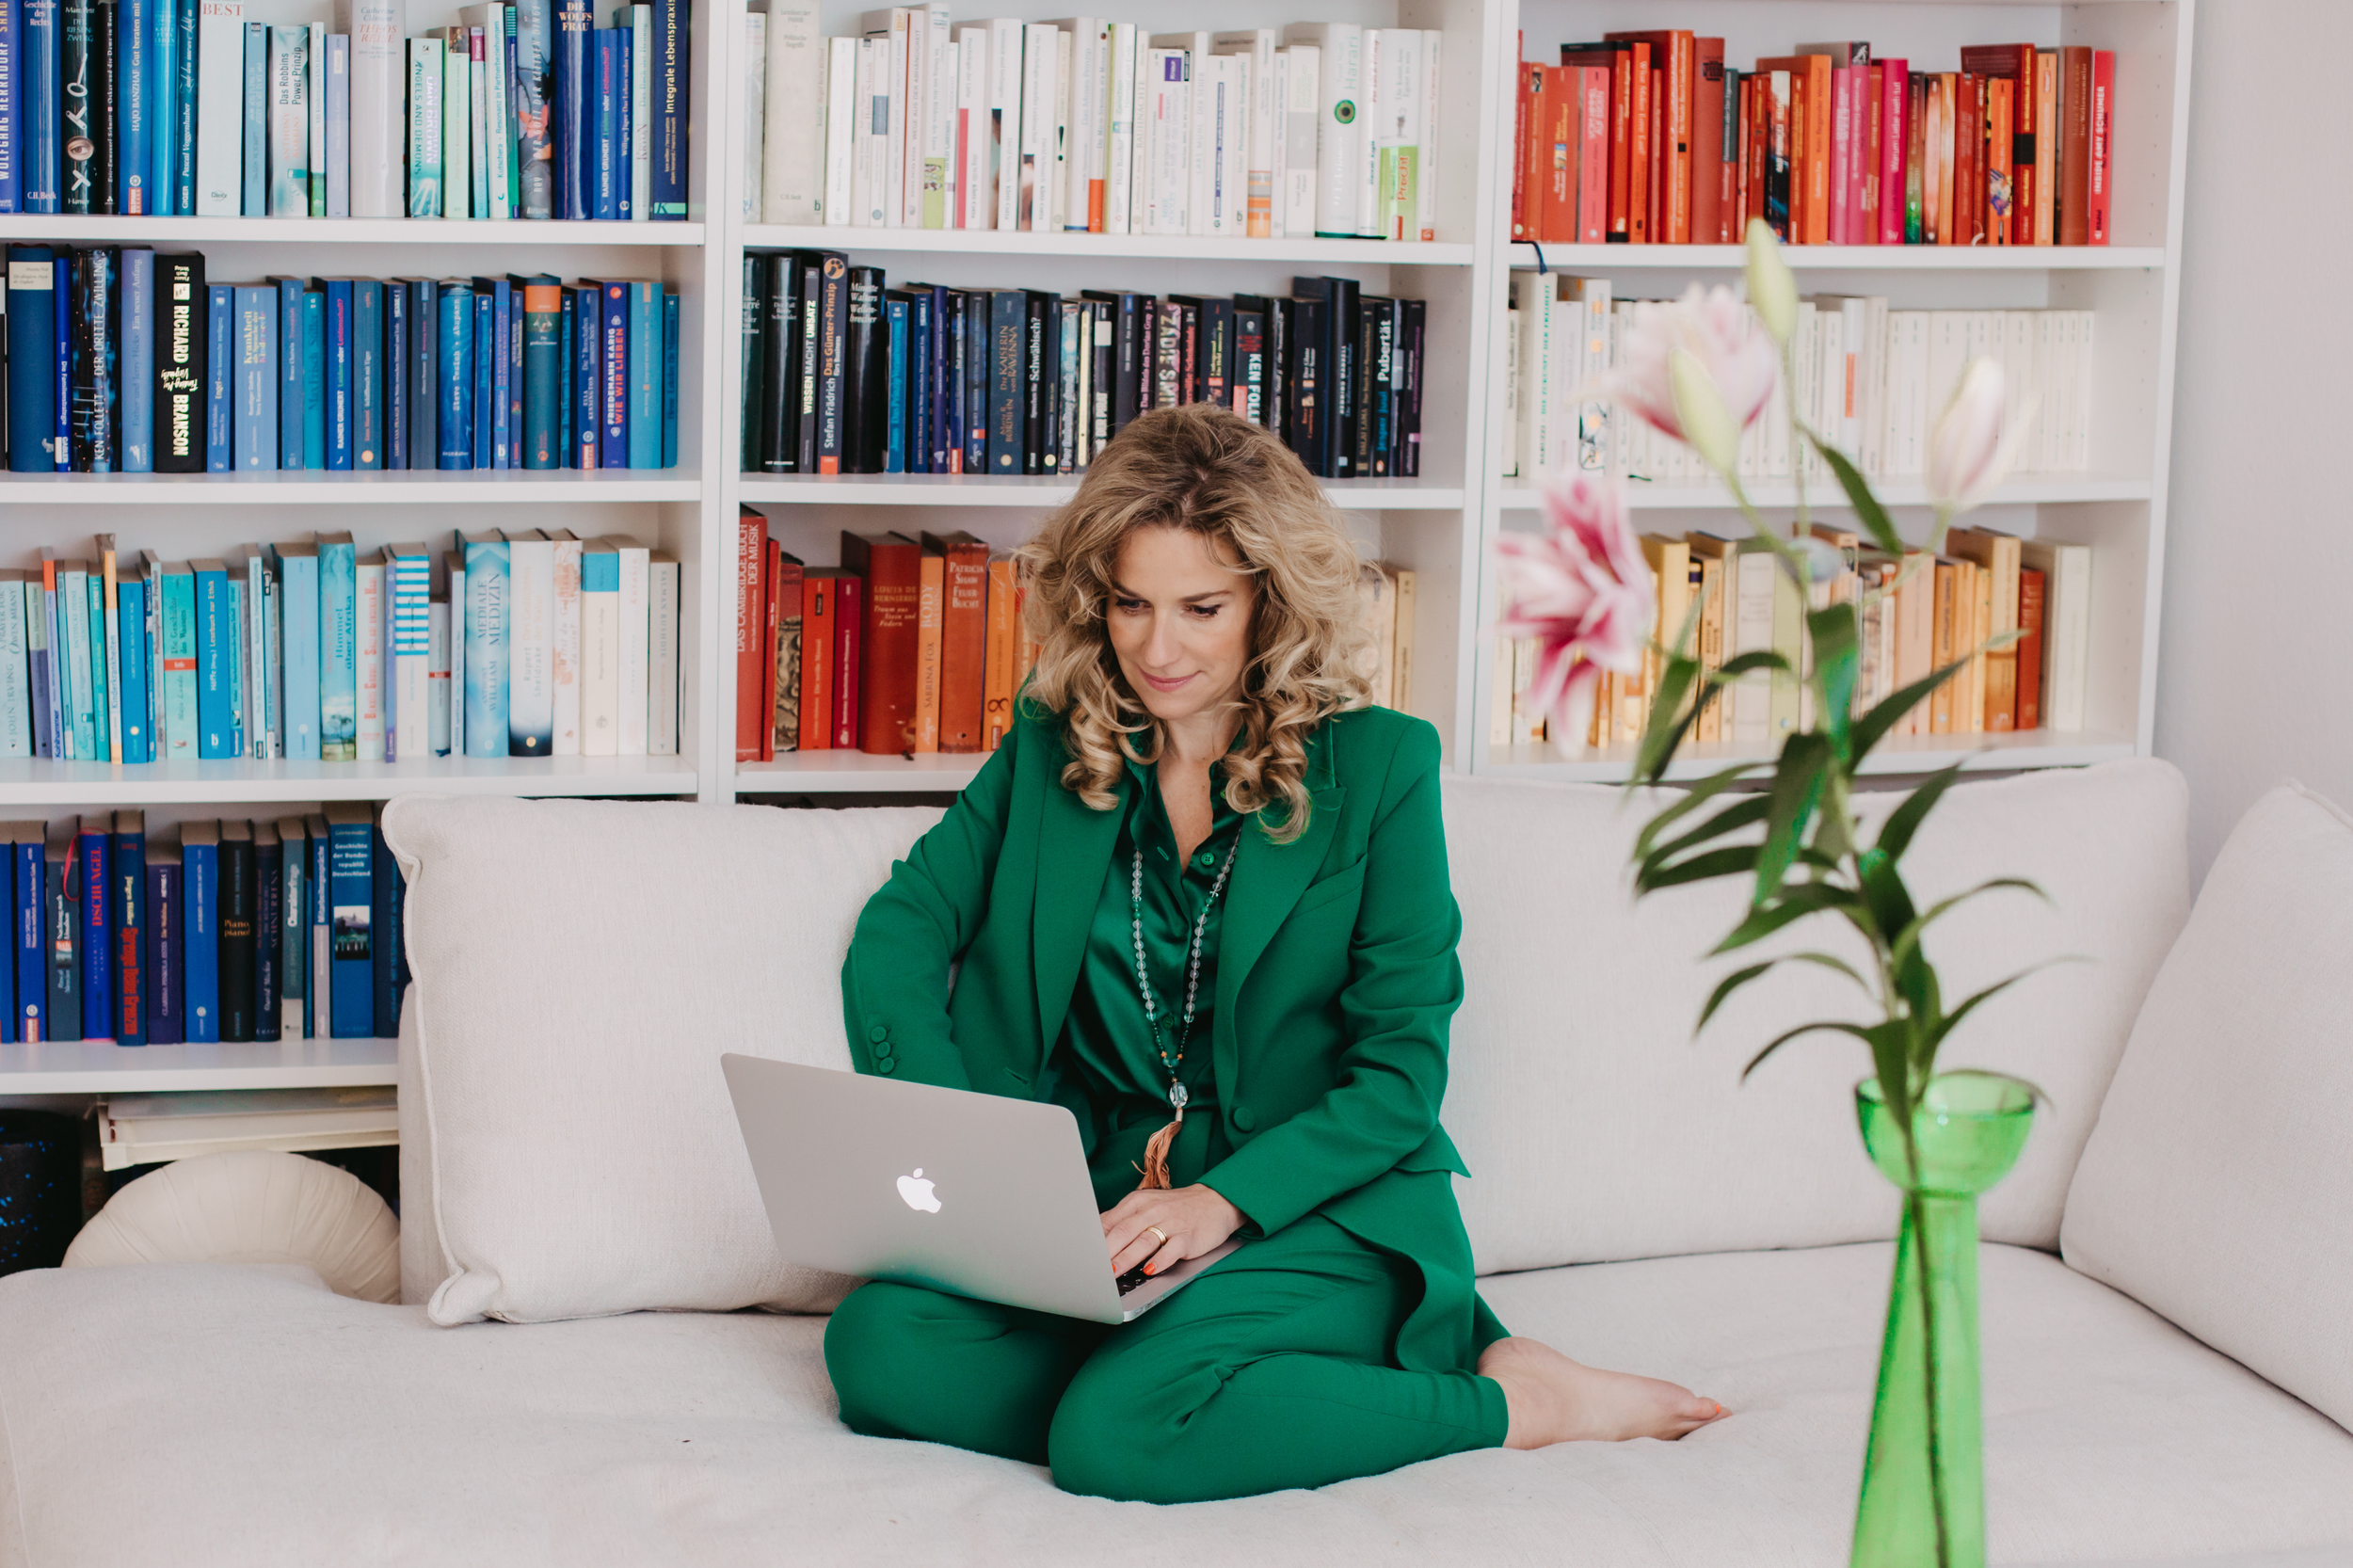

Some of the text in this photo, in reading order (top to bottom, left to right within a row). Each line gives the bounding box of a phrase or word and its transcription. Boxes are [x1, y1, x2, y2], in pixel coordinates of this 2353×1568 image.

[202, 2, 243, 16] BEST
[559, 11, 592, 22] WOLFS
[562, 22, 589, 31] FRAU
[567, 2, 585, 10] DIE
[132, 4, 140, 131] HAJO BANZHAF Gut beraten mit
[279, 54, 288, 104] Das Robbins
[292, 47, 303, 104] Power Prinzip
[493, 21, 504, 90] Partnerbeziehungen
[664, 0, 677, 113] Integrale Lebenspraxis
[182, 104, 191, 151] Voggenhuber
[414, 60, 423, 175] ANGELS AND DEMONS
[425, 76, 439, 164] DAN BROWN
[601, 95, 610, 111] oder
[182, 152, 190, 177] Pascal
[601, 138, 610, 170] GRUNERT
[2094, 136, 2104, 159] AMY
[601, 171, 610, 197] RAINER
[1397, 154, 1410, 201] Precht
[2093, 160, 2103, 194] INSIDE
[132, 259, 143, 288] Anfang
[132, 291, 141, 312] neuer
[132, 315, 141, 329] Ein
[94, 259, 104, 459] KEN FOLLETT DER DRITTE ZWILLING
[132, 336, 141, 358] Hicks
[173, 305, 189, 363] RICHARD
[243, 311, 252, 364] Krankheit
[453, 298, 462, 412] Steve Tesich Abspann
[802, 300, 817, 414] WISSEN MACHT UMSATZ
[999, 325, 1008, 376] KAISERIN
[1008, 326, 1017, 376] RAVENNA
[1030, 317, 1041, 381] Schwäbisch?
[1377, 320, 1391, 382] Pubertät
[132, 383, 141, 398] und
[607, 328, 616, 425] FRIEDEMANN KARIG
[615, 328, 623, 424] WIE WIR LIEBEN
[823, 283, 838, 448] Stefan Frädrich Das Günter-Prinzip
[173, 394, 189, 456] BRANSON
[748, 524, 759, 584] DER MUSIK
[950, 562, 984, 573] PATRICIA
[207, 580, 216, 600] Ethik
[477, 580, 488, 639] MEDIALE
[488, 572, 501, 646] MEDIZIN
[920, 583, 934, 629] BODY
[208, 615, 217, 648] Lesebuch
[334, 608, 344, 658] Himmel
[344, 595, 353, 670] über Afrika
[108, 635, 119, 710] Kinderkrankheiten
[488, 661, 497, 712] WILLIAM
[523, 647, 533, 681] Rupert
[533, 647, 542, 697] Sheldrake
[923, 642, 935, 709] SABRINA FOX
[7, 664, 16, 735] JOHN IRVING
[90, 846, 103, 927] DSCHUNGEL
